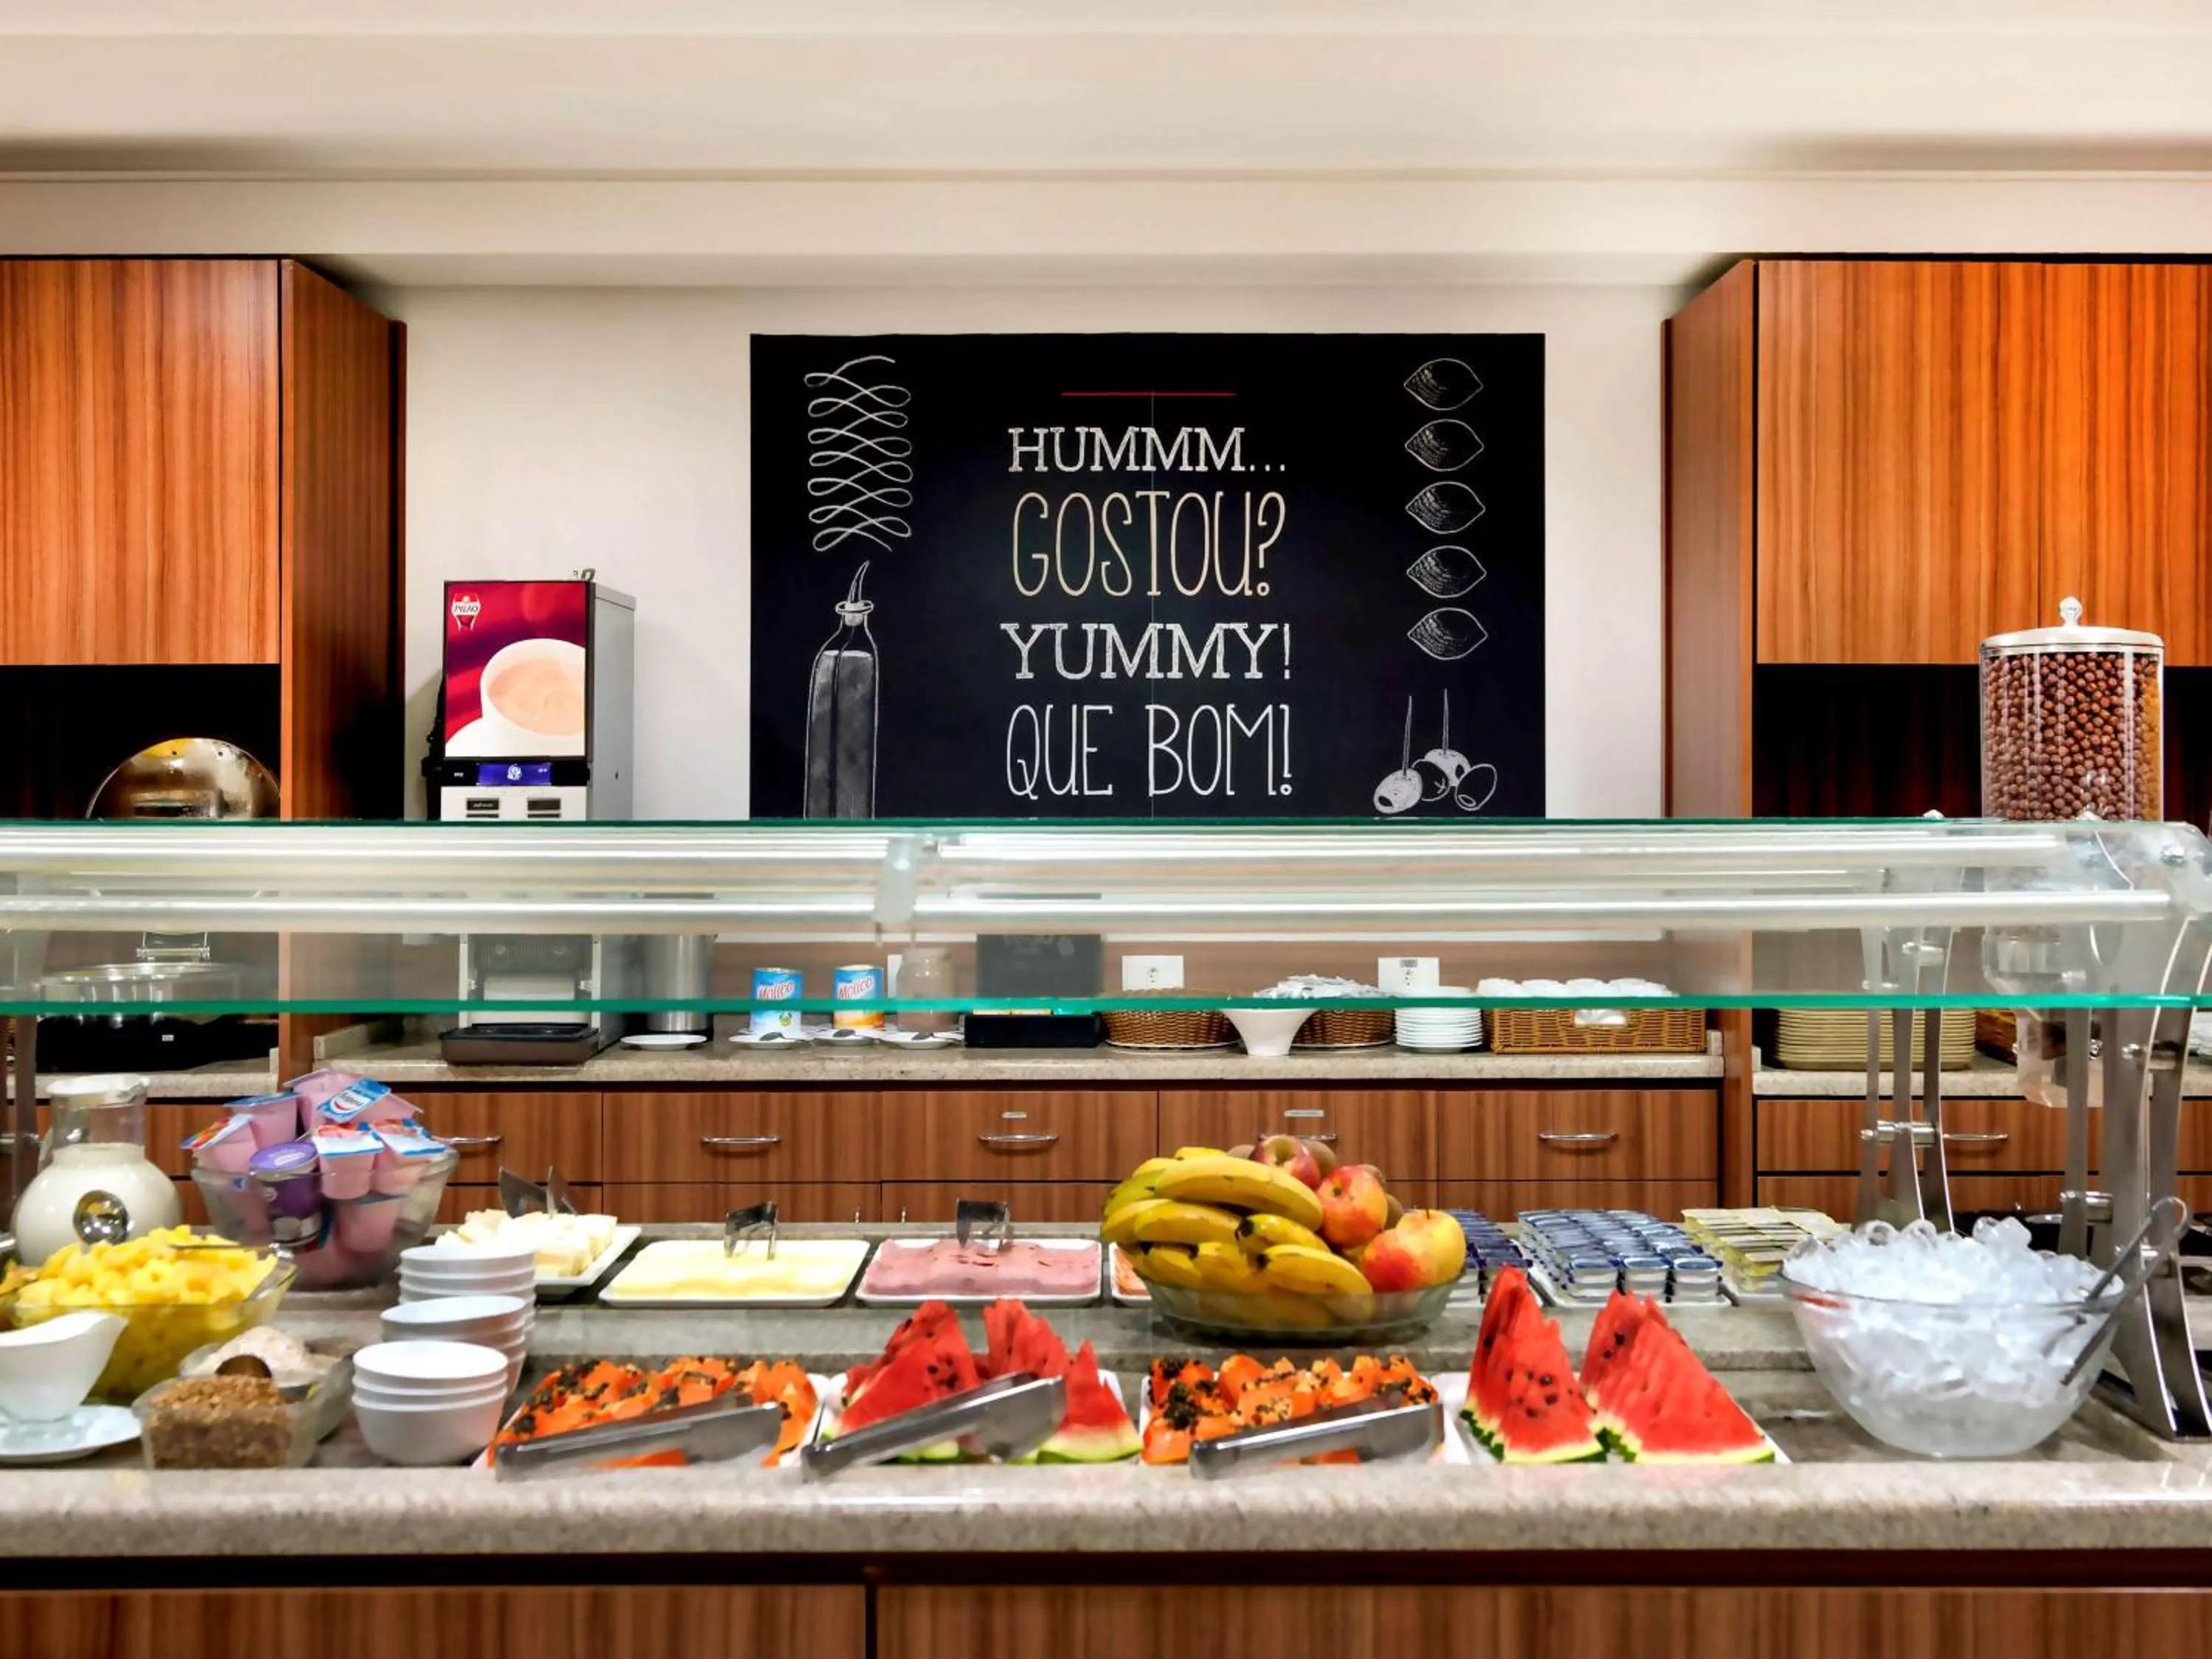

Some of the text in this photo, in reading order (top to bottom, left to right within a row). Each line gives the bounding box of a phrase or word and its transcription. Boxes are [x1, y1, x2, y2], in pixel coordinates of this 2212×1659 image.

[1008, 426, 1286, 472] HUMMM...
[1012, 490, 1286, 597] GOSTOU?
[1000, 623, 1291, 679] YUMMY!
[1006, 704, 1292, 800] QUE BOM!
